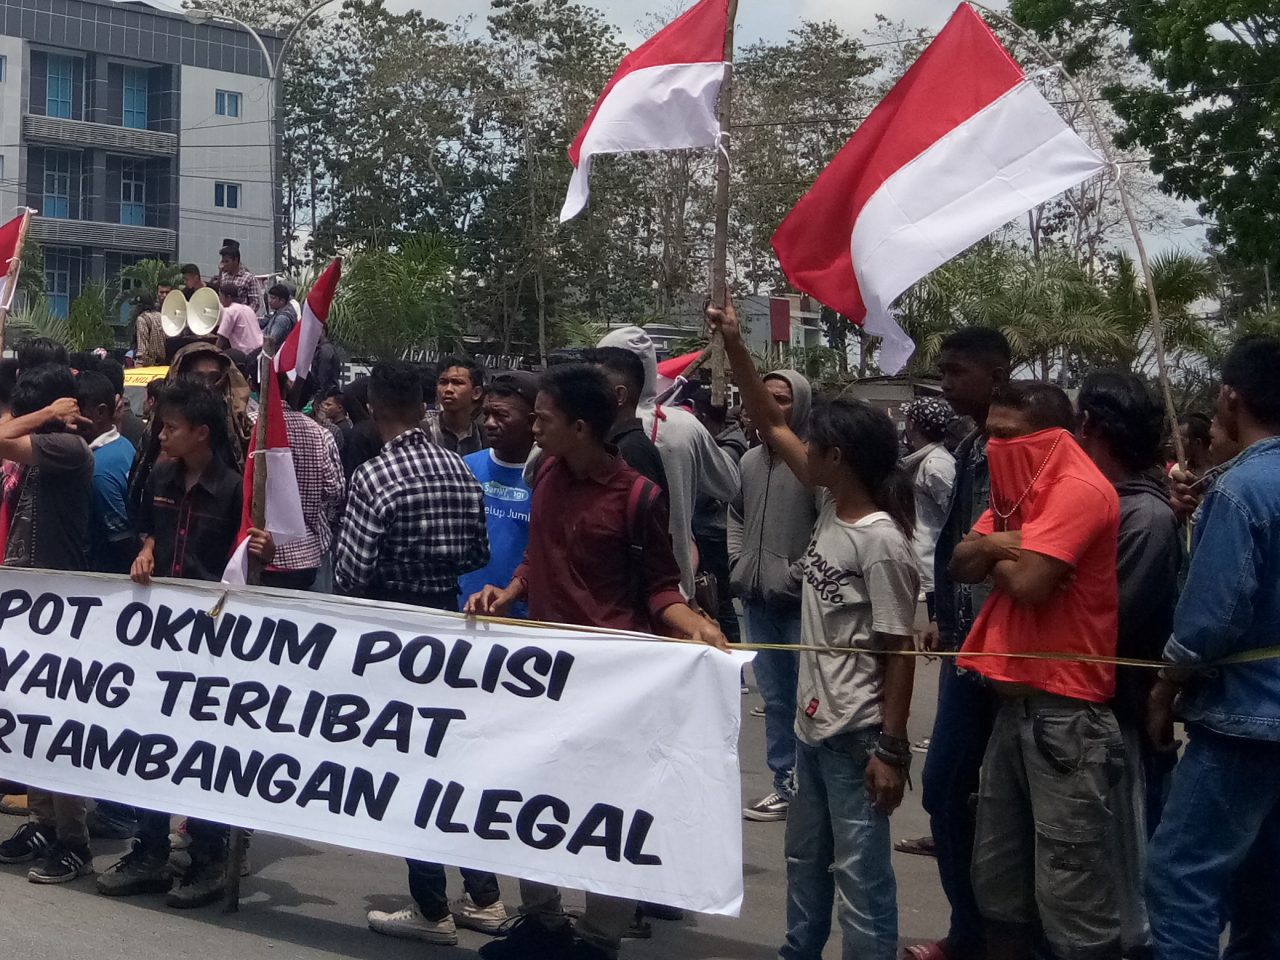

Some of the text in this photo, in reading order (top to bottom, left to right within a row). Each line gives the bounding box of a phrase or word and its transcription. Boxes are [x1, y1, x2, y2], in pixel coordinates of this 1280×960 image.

[484, 505, 506, 518] elup
[116, 601, 337, 671] OKNUM
[351, 630, 575, 702] POLISI
[155, 670, 467, 758] TERLIBAT
[414, 777, 663, 866] ILEGAL
